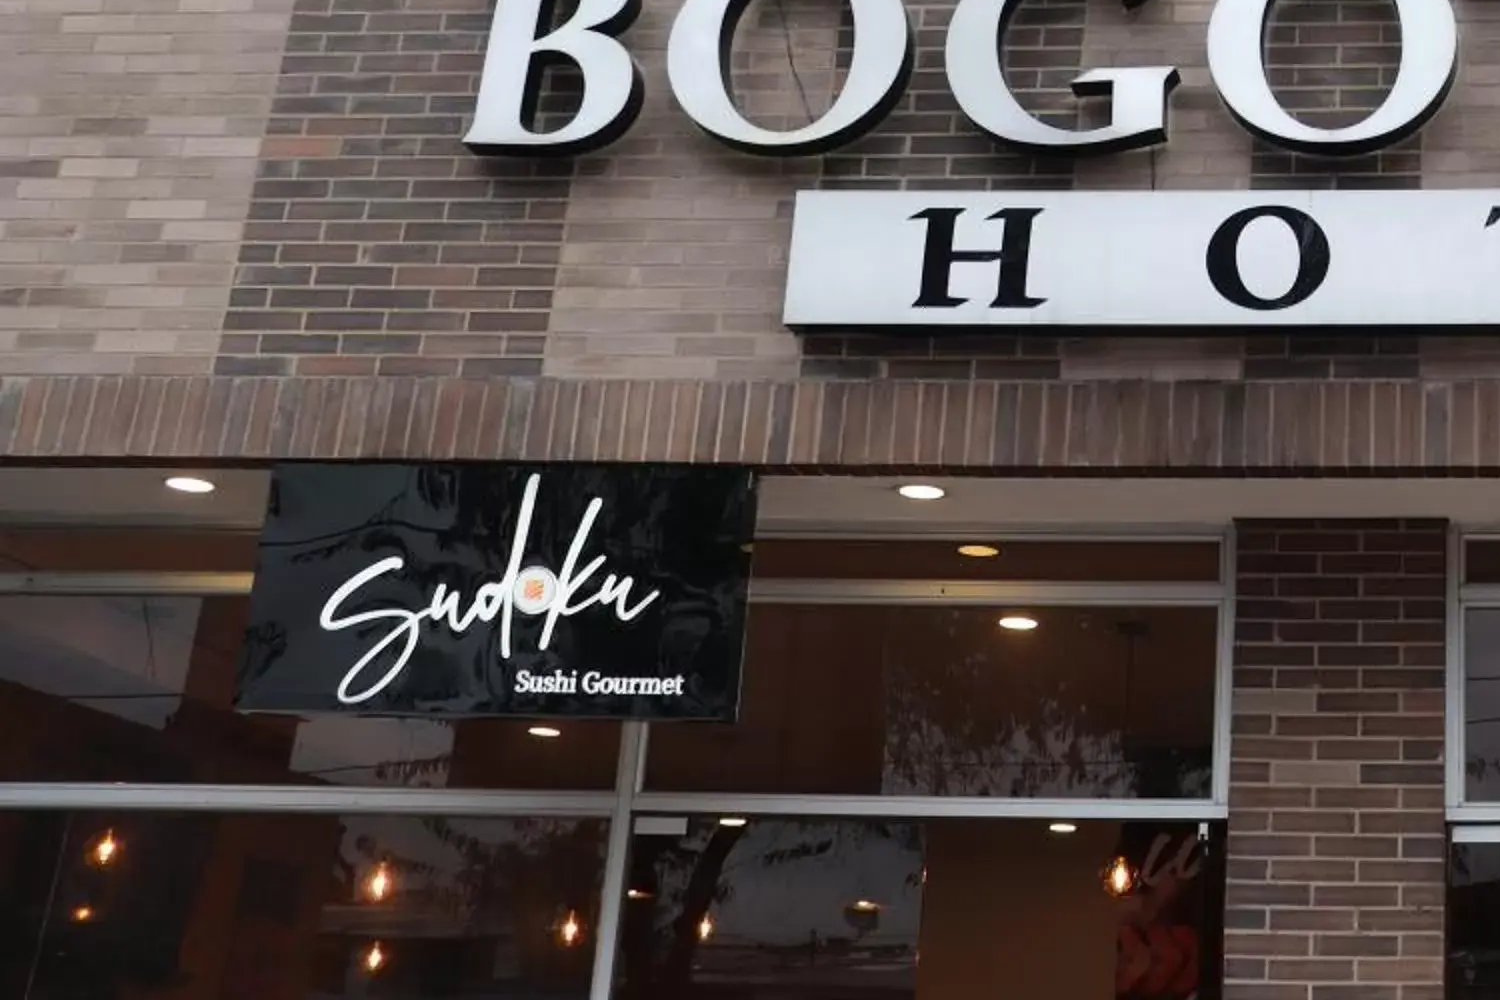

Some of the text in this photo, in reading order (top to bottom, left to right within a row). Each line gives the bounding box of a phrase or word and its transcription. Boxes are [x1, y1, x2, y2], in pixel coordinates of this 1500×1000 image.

[319, 472, 660, 704] Sudoku
[514, 669, 685, 696] Sushi Gourmet
